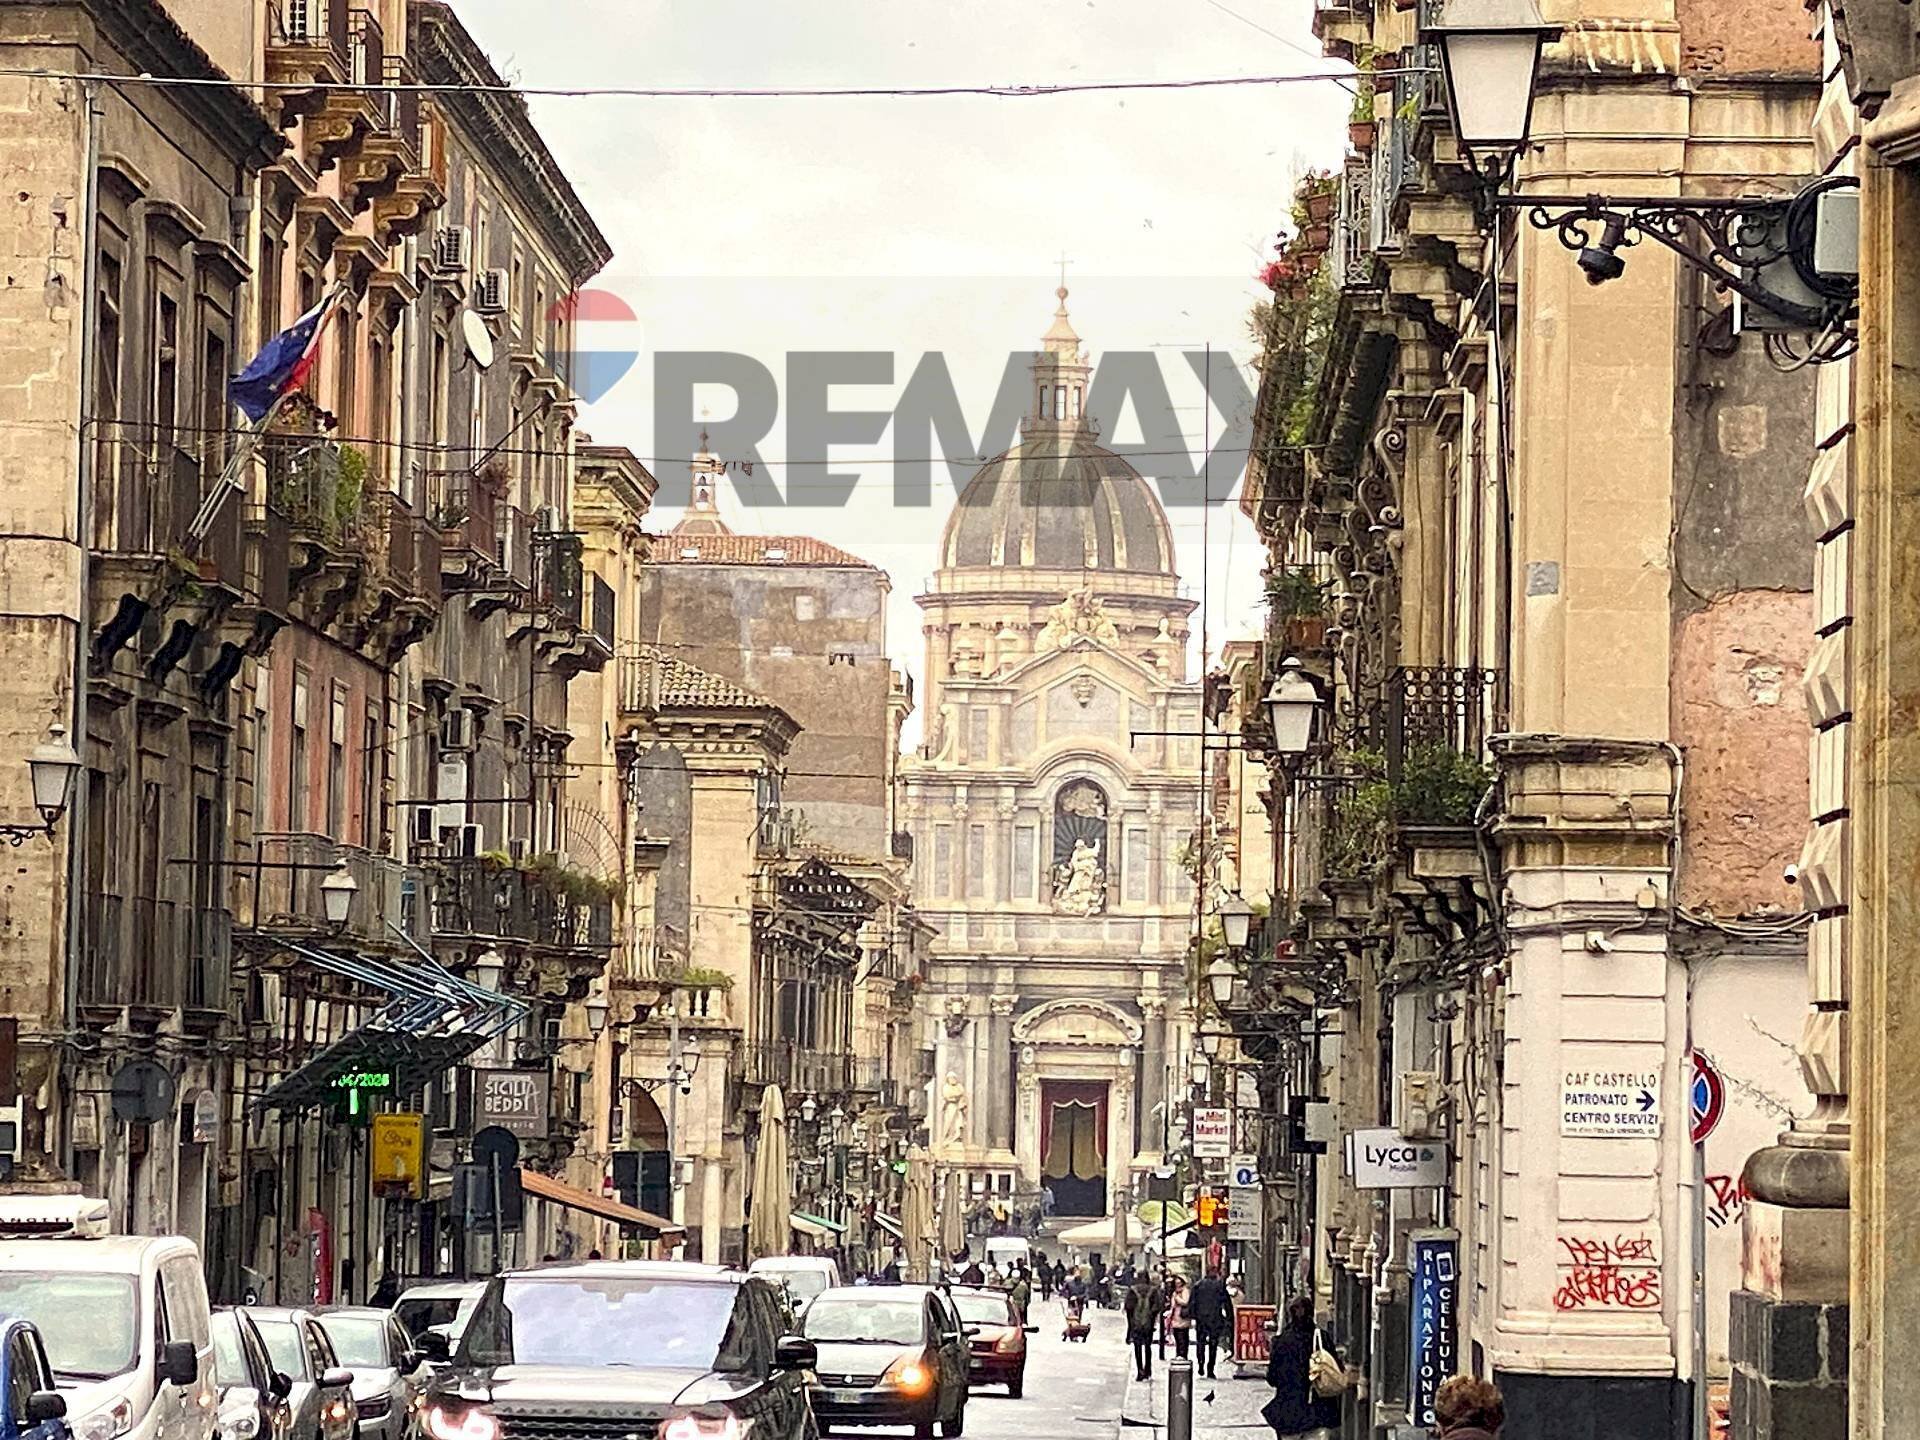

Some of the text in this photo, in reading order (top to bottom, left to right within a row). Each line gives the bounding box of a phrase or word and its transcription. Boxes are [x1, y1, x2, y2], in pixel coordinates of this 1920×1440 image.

[485, 1080, 540, 1097] SICILIA
[1565, 1072, 1656, 1088] CAF CASTELLO
[1565, 1093, 1628, 1106] PATRONATO
[1563, 1112, 1659, 1126] CENTRO SERVIZI
[1365, 1145, 1417, 1167] Lyca
[1421, 1249, 1434, 1407] RIPARAZIONE
[1438, 1287, 1451, 1386] CELLULA
